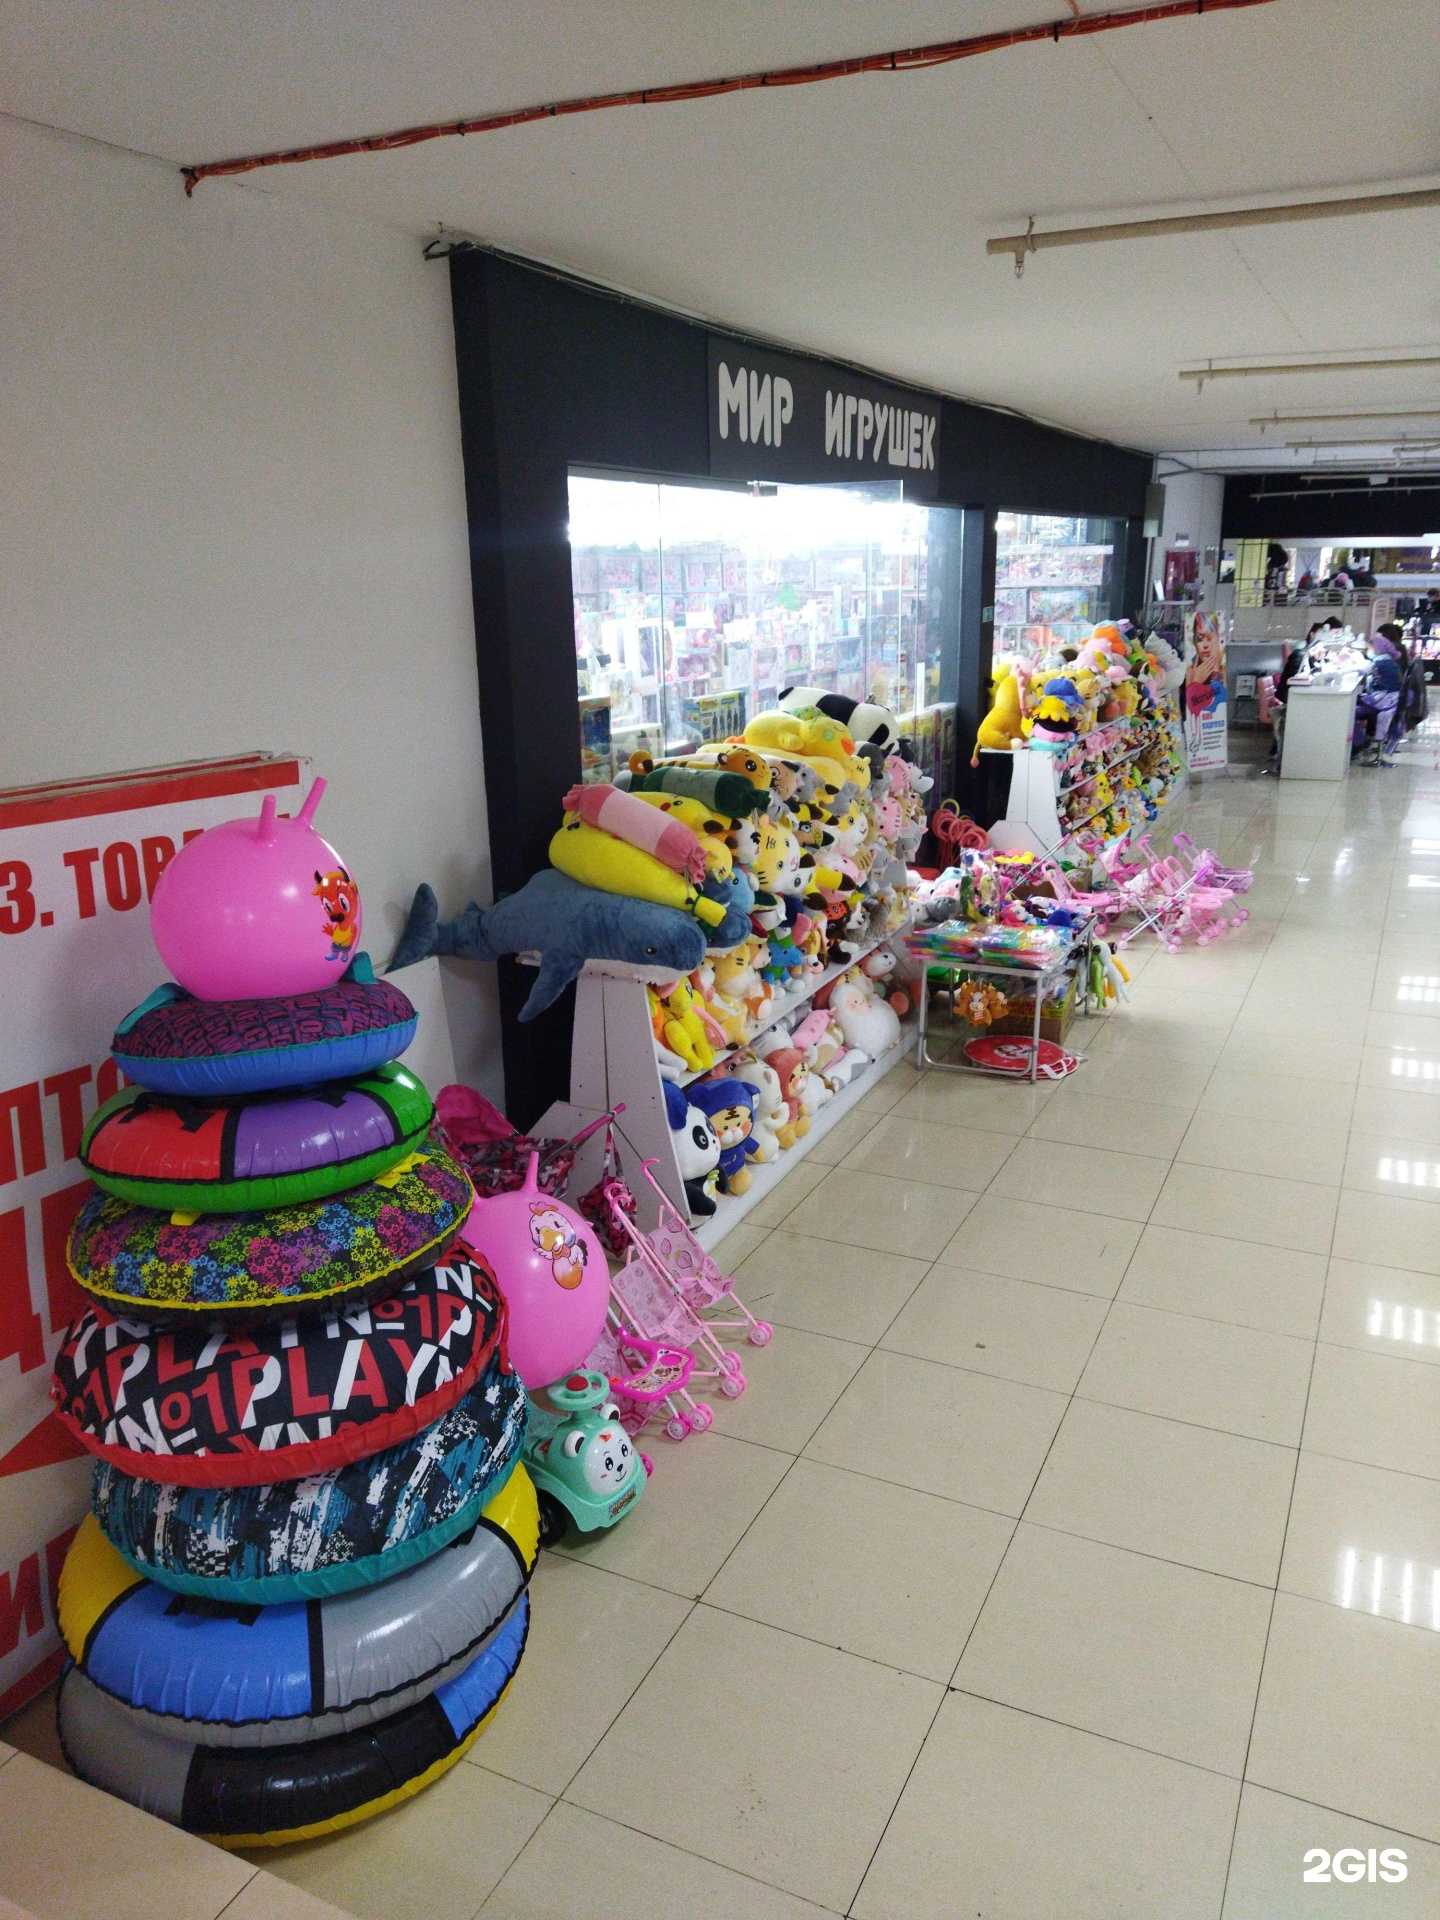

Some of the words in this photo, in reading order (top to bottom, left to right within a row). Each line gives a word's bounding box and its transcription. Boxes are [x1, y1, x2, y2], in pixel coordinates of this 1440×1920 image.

[718, 361, 794, 448] МИР
[824, 389, 937, 471] ИГРУШЕК
[0, 860, 55, 935] 3.
